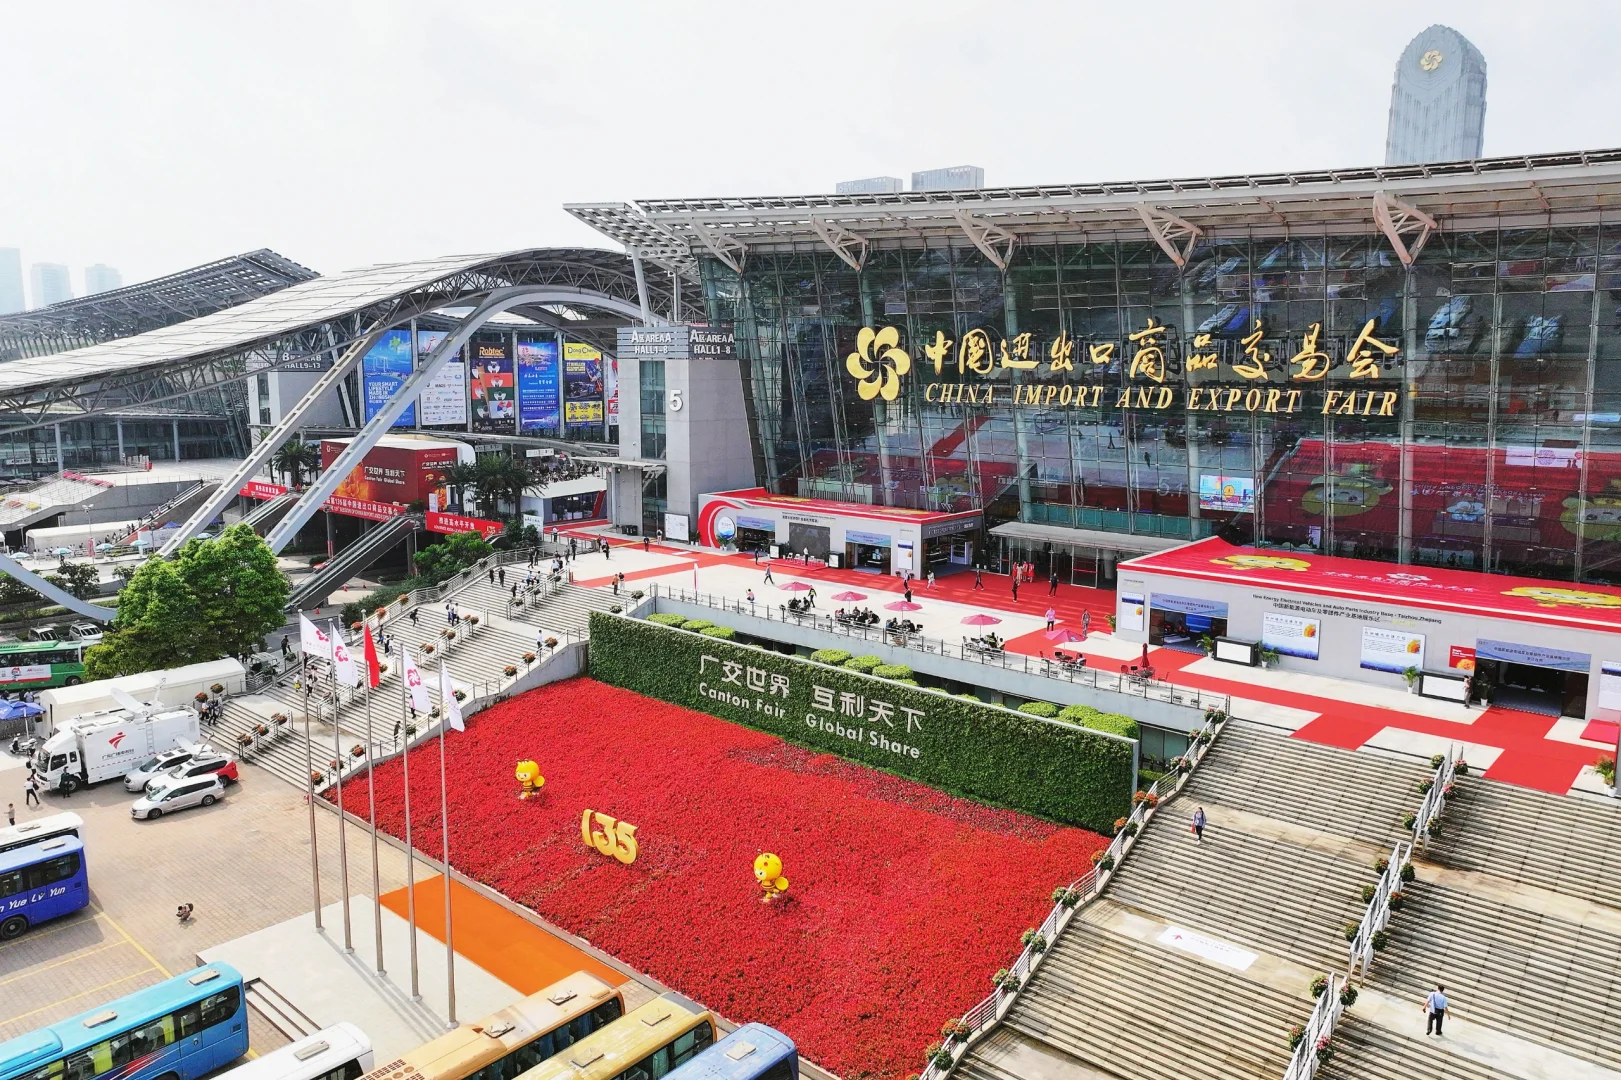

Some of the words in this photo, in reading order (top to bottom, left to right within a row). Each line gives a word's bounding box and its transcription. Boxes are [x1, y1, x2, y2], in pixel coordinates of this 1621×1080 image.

[669, 389, 683, 412] 5
[925, 383, 993, 405] CHINA
[1013, 384, 1104, 408] IMPORT
[1115, 386, 1173, 410] AND
[1187, 387, 1301, 414] EXPORT
[1321, 389, 1397, 417] FAIR
[699, 654, 790, 699] 广交世界
[811, 684, 926, 733] 互利天下
[699, 682, 750, 709] Canton
[756, 699, 786, 719] Fair
[805, 714, 863, 742] Global
[869, 731, 921, 759] Share
[581, 808, 640, 864] 135
[50, 886, 66, 897] Yun
